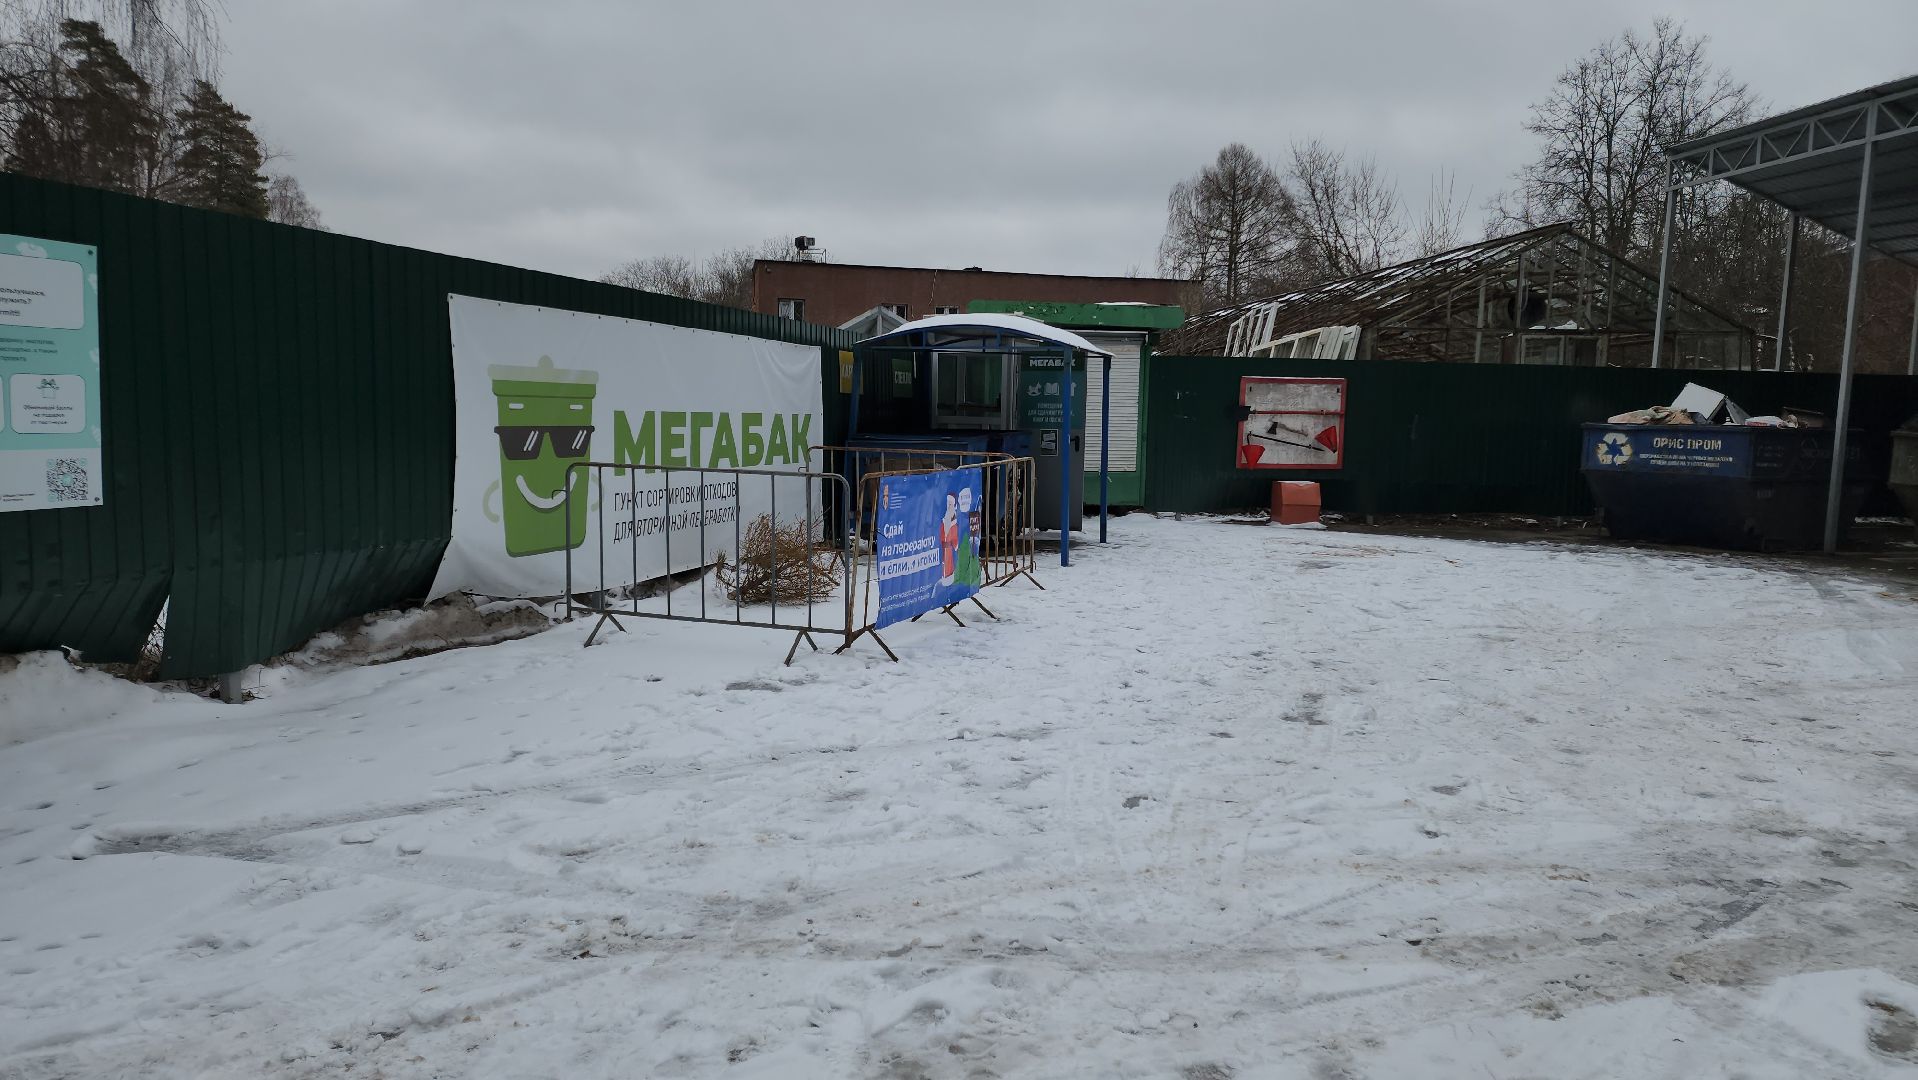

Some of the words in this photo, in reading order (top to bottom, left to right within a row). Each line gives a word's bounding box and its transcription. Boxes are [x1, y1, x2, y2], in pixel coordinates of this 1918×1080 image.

[613, 410, 812, 476] МЕГАБАК
[1687, 439, 1722, 451] ПРОМ
[703, 481, 737, 501] ОТХОДОВ
[614, 520, 633, 544] ДЛЯ
[690, 504, 741, 528] ПЕЕРАБОТК
[883, 520, 904, 538] Сдай
[881, 545, 892, 557] на
